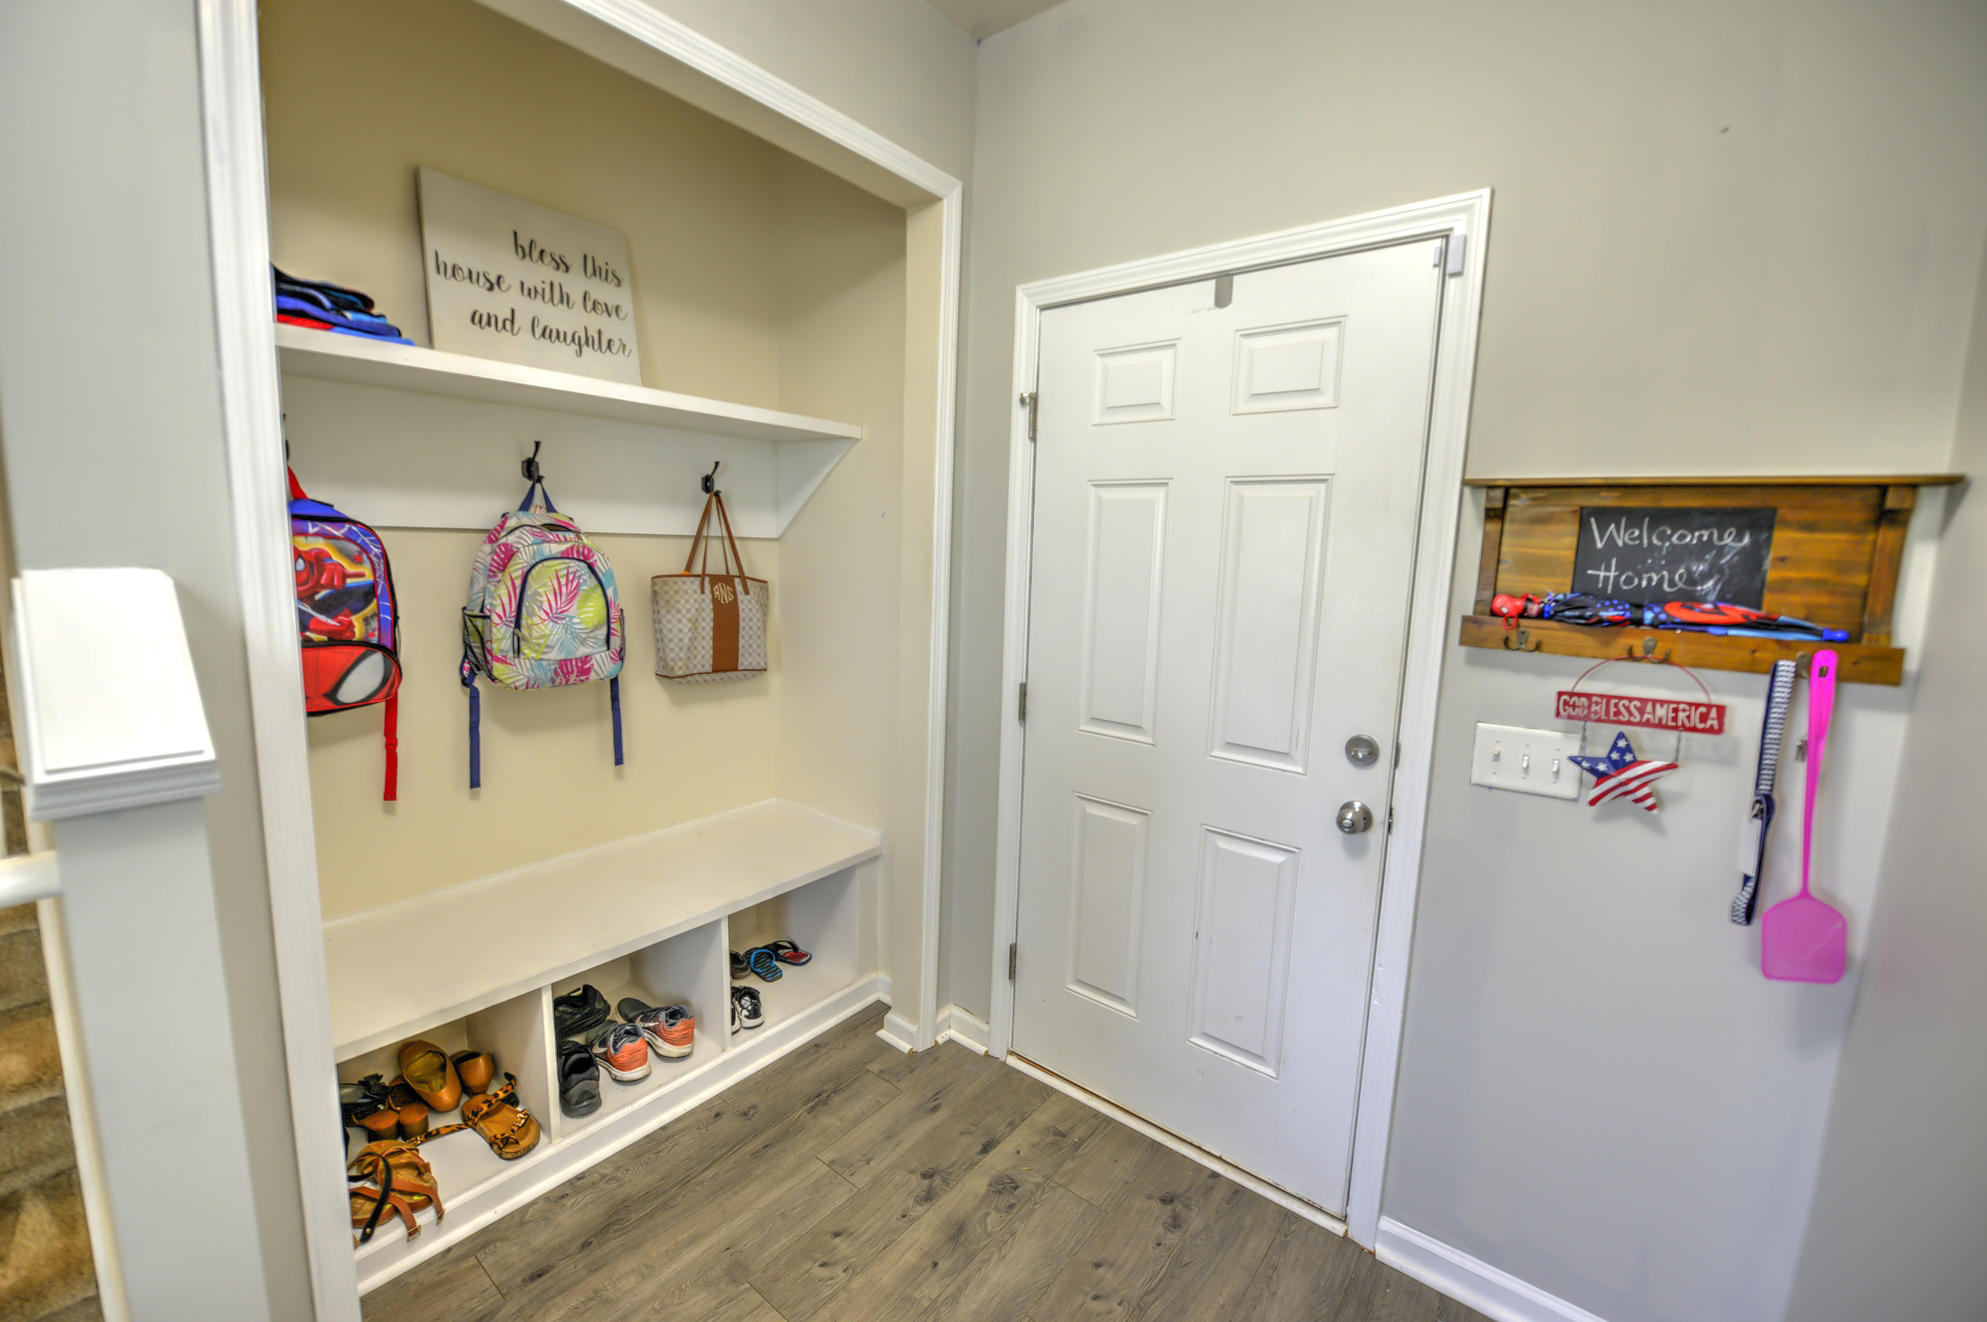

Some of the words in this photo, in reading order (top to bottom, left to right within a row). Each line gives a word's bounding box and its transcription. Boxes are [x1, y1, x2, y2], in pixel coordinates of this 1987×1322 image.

[512, 229, 571, 274] bless
[582, 252, 624, 288] this
[433, 248, 512, 293] house
[519, 279, 576, 310] with
[582, 290, 629, 321] love
[470, 307, 522, 336] and
[530, 315, 633, 358] laughter
[1590, 516, 1751, 550] Welcome
[1586, 556, 1721, 594] Home
[1558, 695, 1588, 716] GOD
[1590, 696, 1641, 723] BLESS
[1642, 702, 1719, 730] AMERICA
